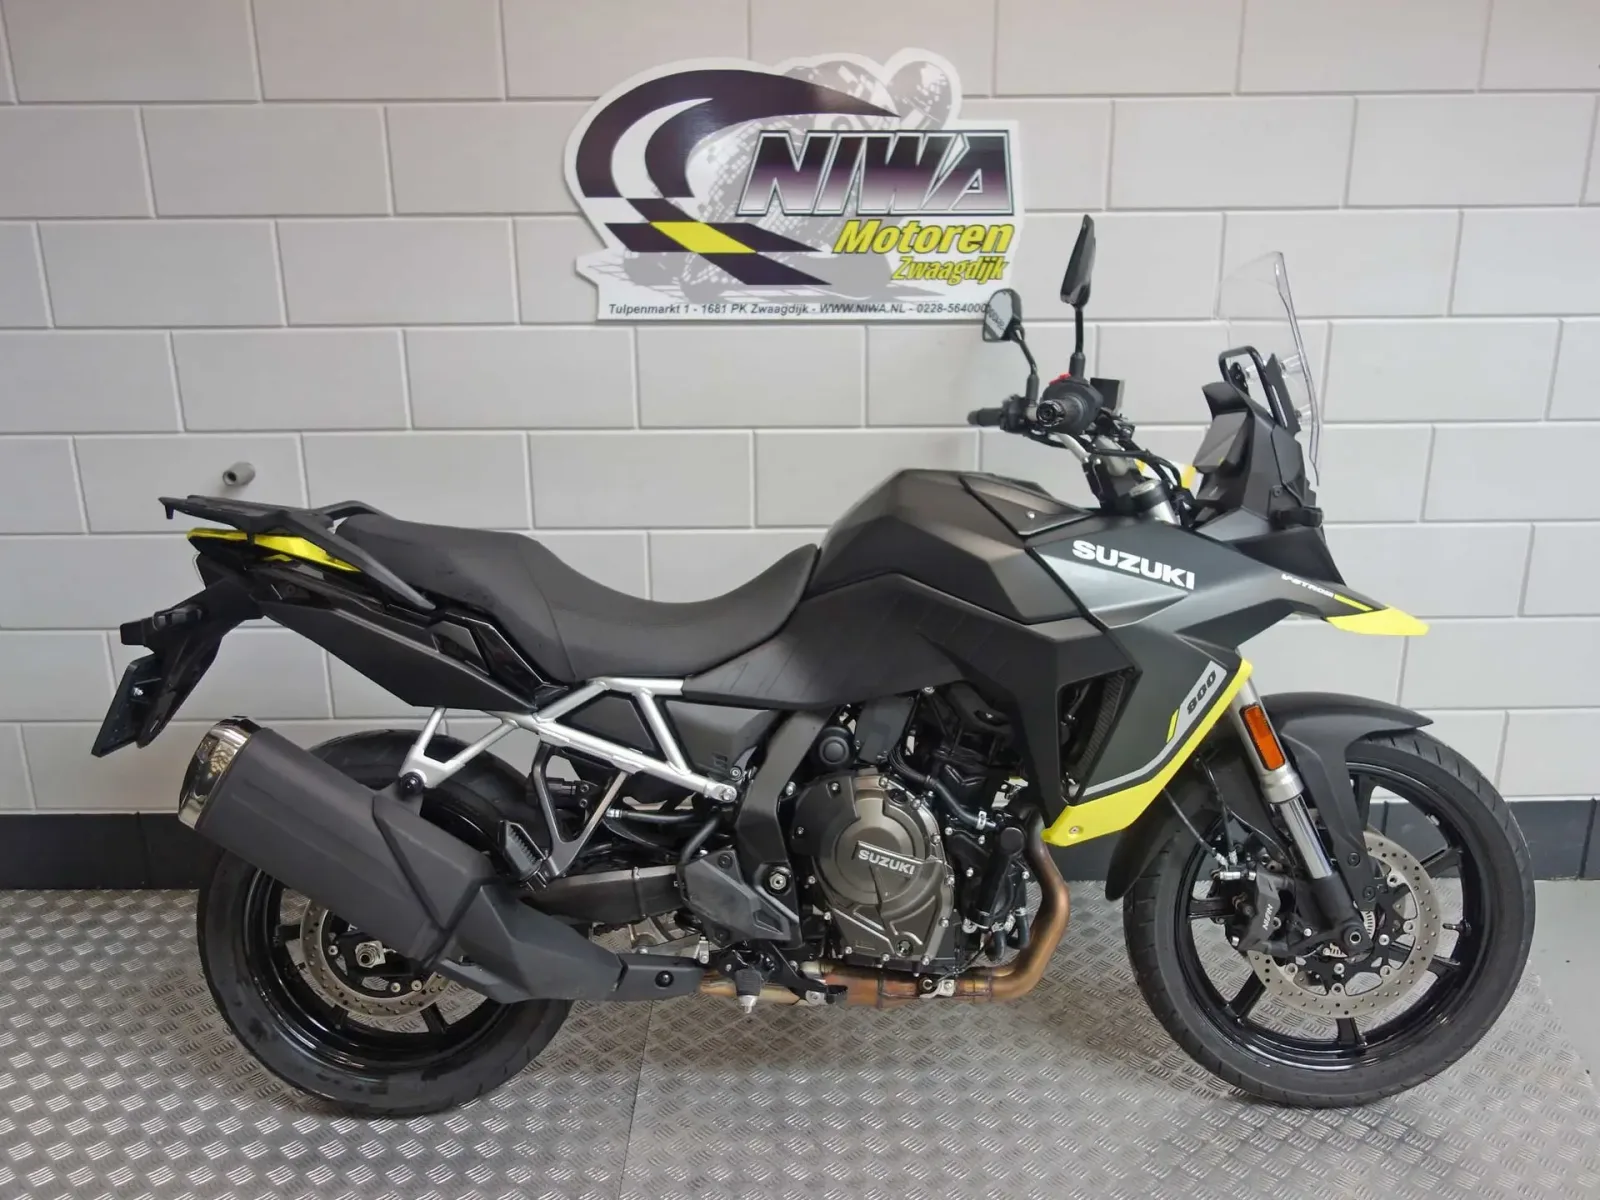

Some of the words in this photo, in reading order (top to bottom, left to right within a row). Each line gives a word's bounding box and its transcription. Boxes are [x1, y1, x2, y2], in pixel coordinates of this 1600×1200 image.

[735, 129, 1015, 216] NIWA
[831, 219, 1015, 255] Motoren
[891, 256, 1009, 285] Zwaagdijk
[609, 303, 681, 316] Tulpenmarkt
[684, 303, 690, 314] 1
[701, 303, 727, 314] 1681
[731, 303, 748, 314] PK
[750, 303, 809, 316] Zwaagdijk
[819, 303, 906, 314] WWW.NIWA.NL
[916, 302, 987, 314] 0228-564000
[1072, 539, 1195, 590] SUZUKI
[1187, 670, 1217, 715] 800
[858, 849, 916, 875] SUZUKI
